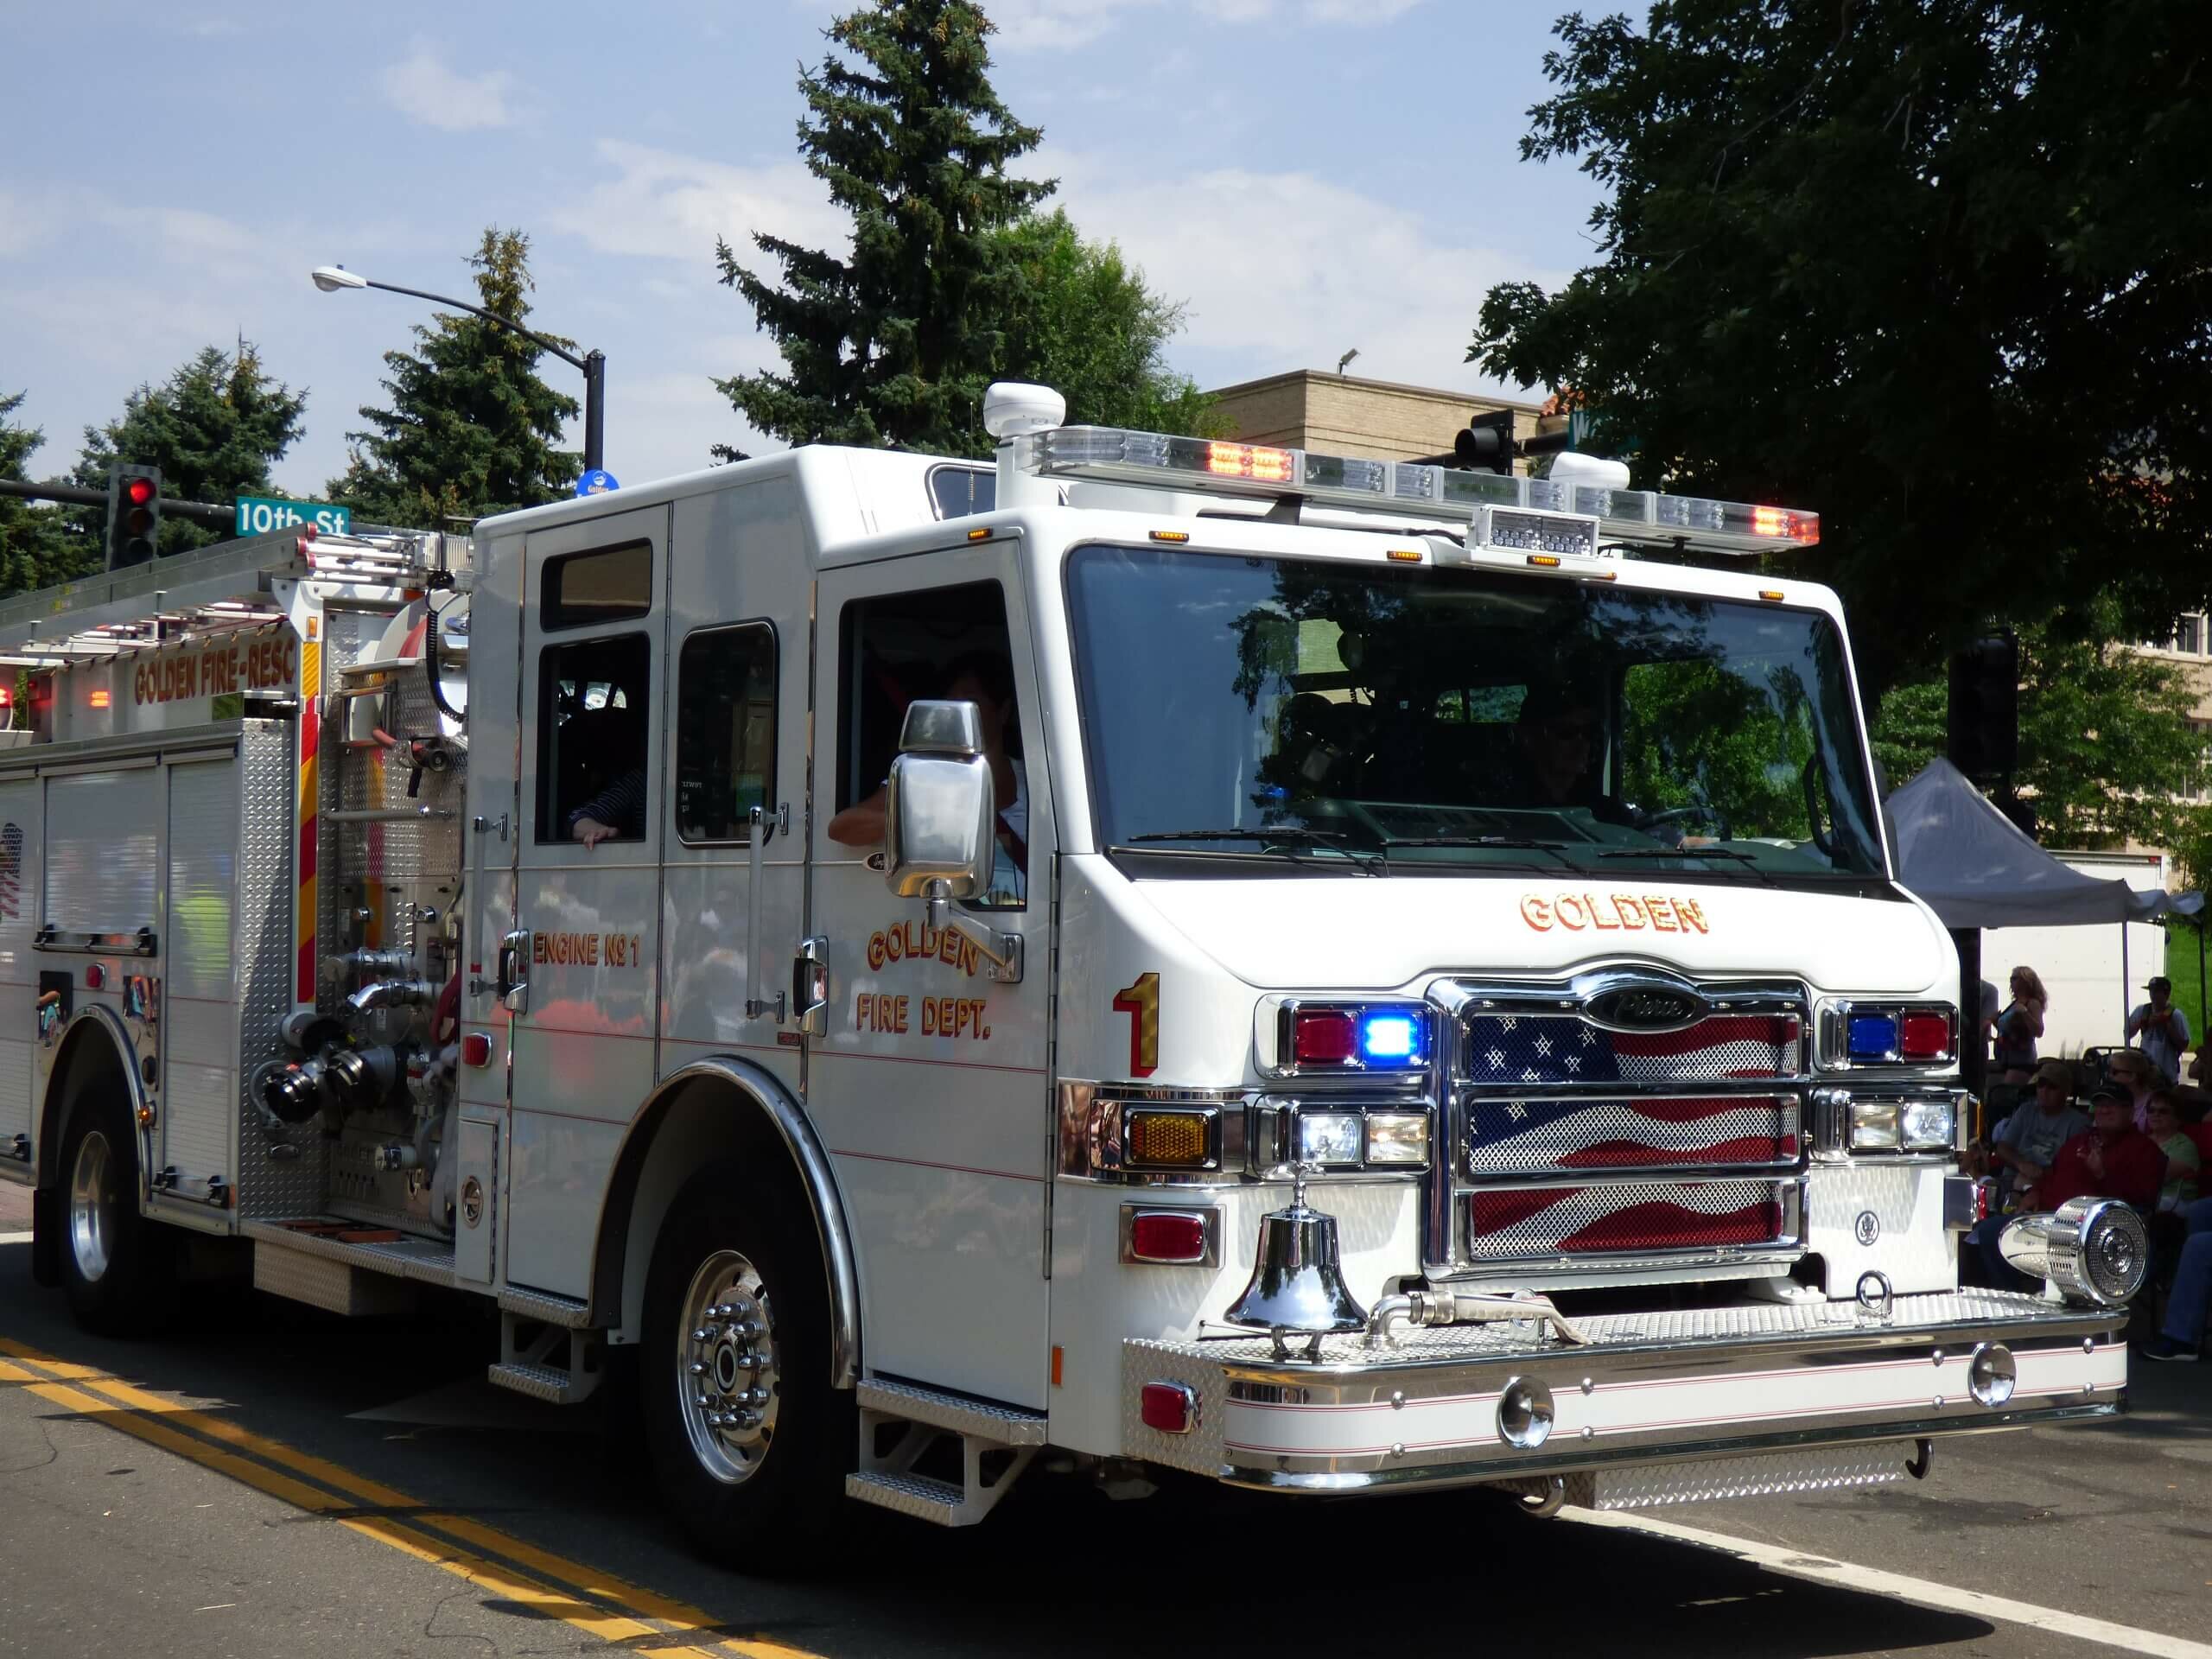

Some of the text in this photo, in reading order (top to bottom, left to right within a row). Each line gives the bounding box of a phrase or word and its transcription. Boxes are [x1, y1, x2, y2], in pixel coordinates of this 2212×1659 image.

[241, 503, 345, 534] 10th St
[135, 656, 198, 706] GOLDEN
[1521, 893, 1709, 934] GOLDEN
[533, 932, 599, 966] ENGINE
[868, 919, 980, 976] GOLDEN
[856, 994, 991, 1039] FIRE DEPT.
[1113, 972, 1160, 1078] 1
